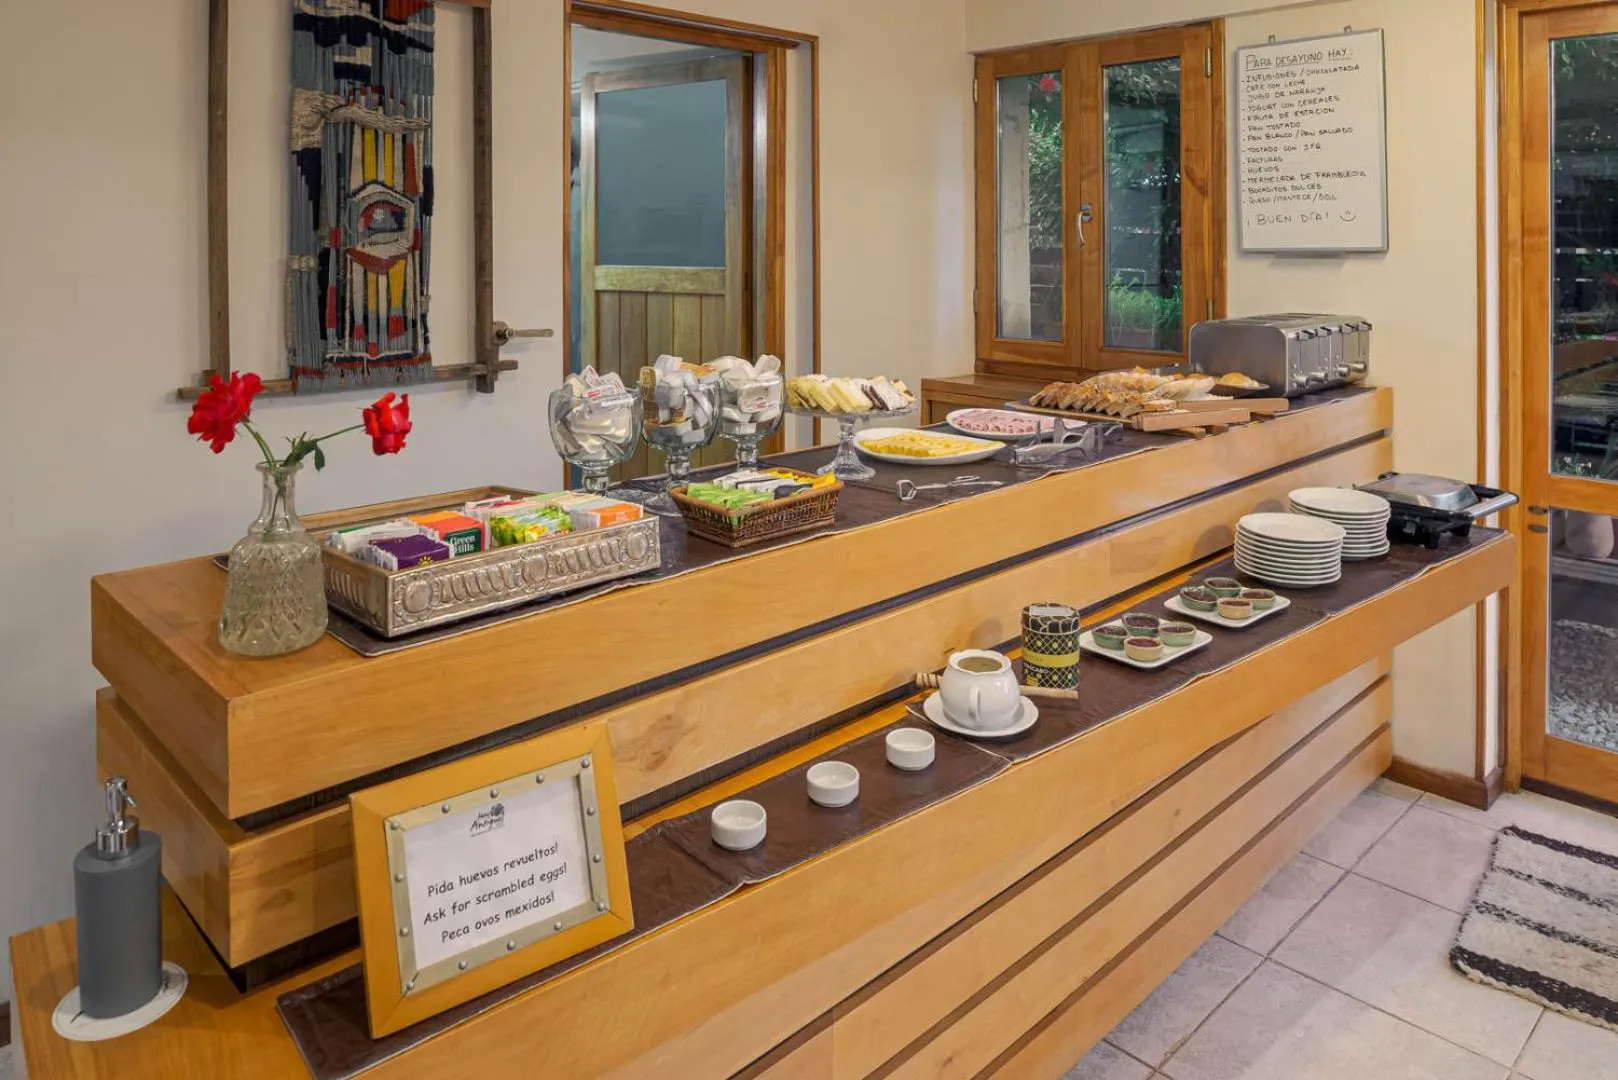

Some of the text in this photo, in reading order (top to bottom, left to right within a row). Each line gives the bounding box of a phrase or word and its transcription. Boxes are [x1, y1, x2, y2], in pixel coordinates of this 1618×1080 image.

[1245, 54, 1272, 69] PARA
[1276, 51, 1323, 66] DESAYUNO
[1285, 79, 1305, 88] LECHE
[1290, 86, 1325, 96] NARANJA
[1297, 94, 1340, 107] CEREALES
[1279, 111, 1289, 119] DE
[1266, 121, 1301, 130] TOSTADO
[1301, 129, 1316, 137] PAN
[1248, 165, 1280, 174] HUEVOS
[1300, 172, 1313, 181] DE
[1291, 183, 1322, 191] DULCES
[450, 535, 476, 546] Green
[427, 841, 558, 897] Pida huevos revueltos!
[423, 861, 567, 926] Ask for scrambled eggs!
[441, 890, 555, 944] Peca ovos mexidos!
